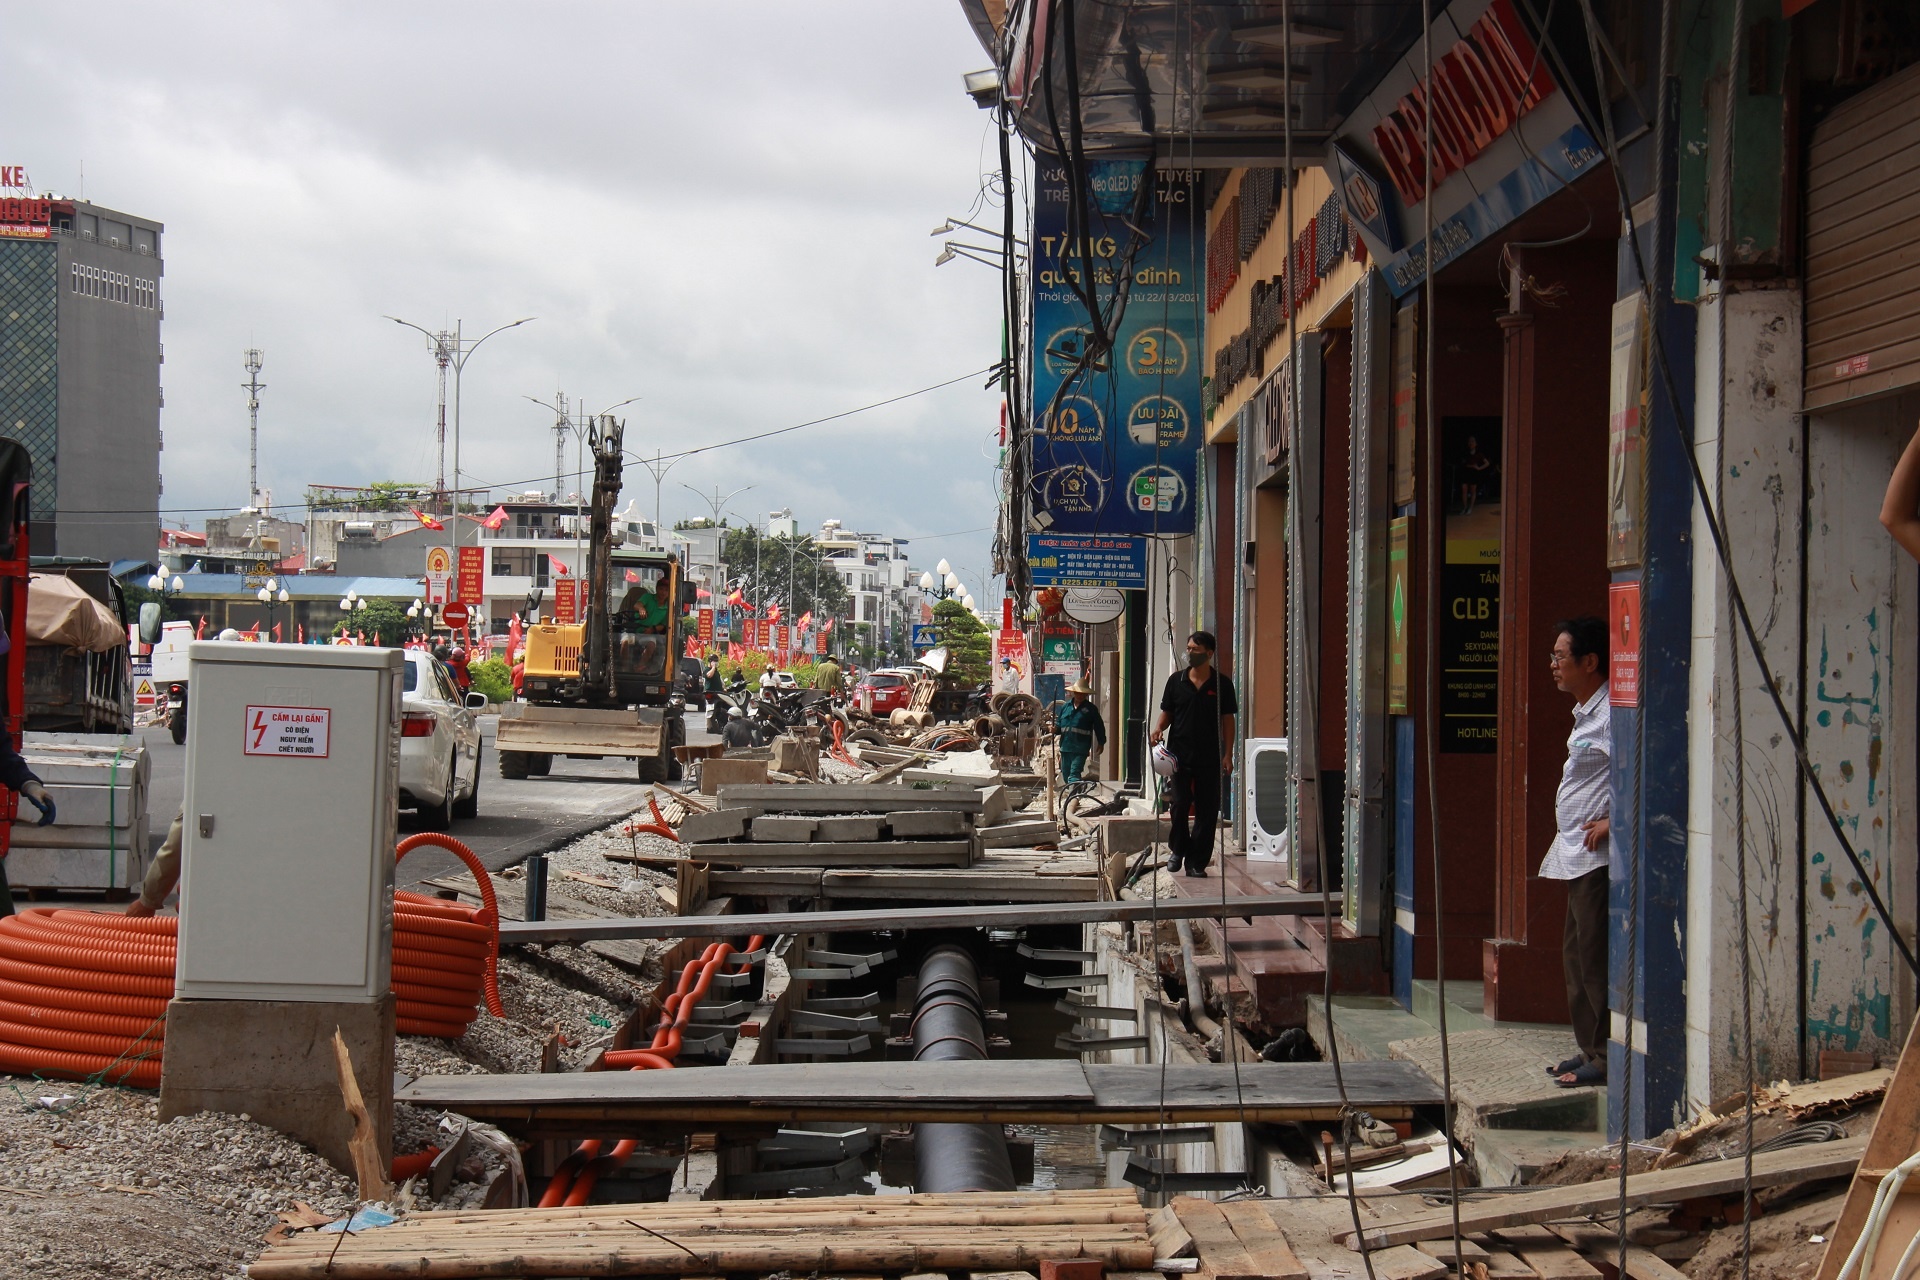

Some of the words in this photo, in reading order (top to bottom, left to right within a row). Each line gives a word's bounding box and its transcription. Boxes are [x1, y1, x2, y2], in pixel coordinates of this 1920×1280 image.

[1092, 178, 1106, 191] Neo
[1108, 176, 1129, 192] QLED
[1135, 266, 1181, 285] đỉnh
[1039, 292, 1060, 301] Thời
[1138, 337, 1157, 366] 3
[1452, 597, 1489, 619] CLB
[272, 712, 289, 722] CẤM
[292, 714, 303, 724] LẠI
[295, 726, 309, 734] ĐIỆN
